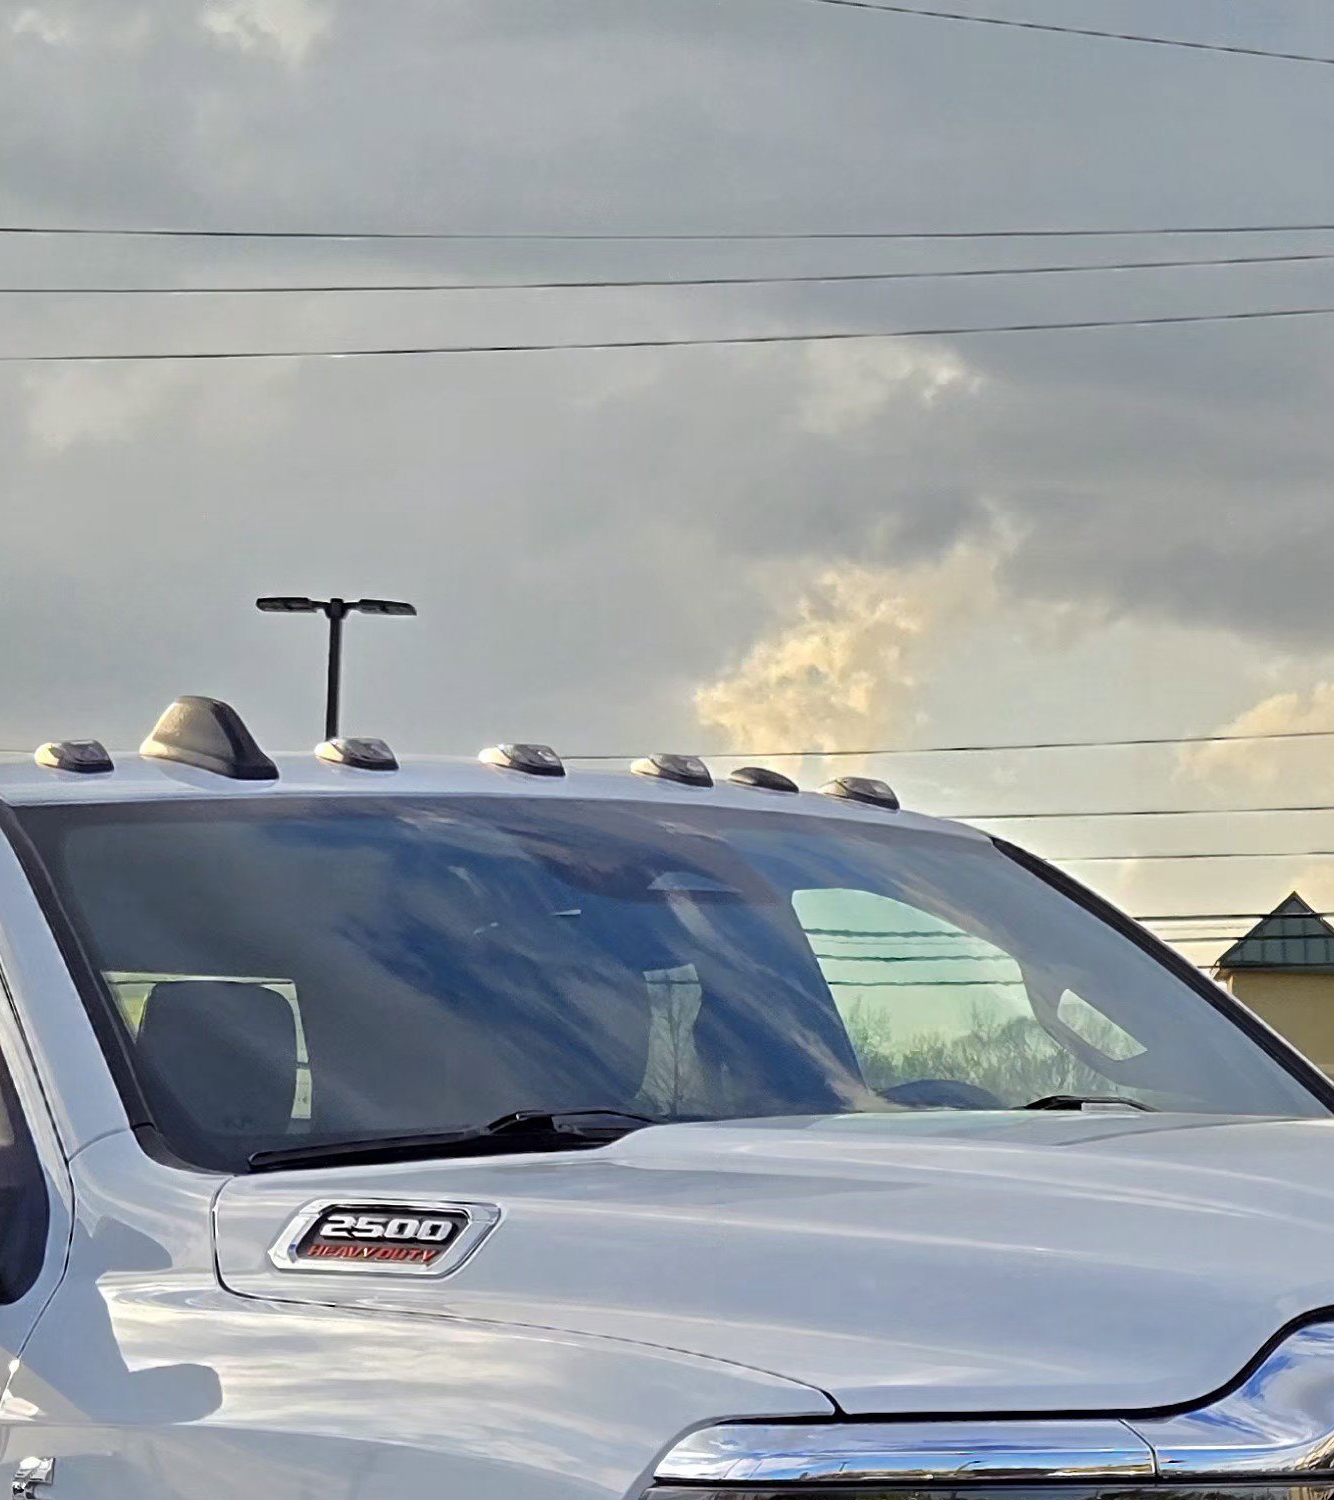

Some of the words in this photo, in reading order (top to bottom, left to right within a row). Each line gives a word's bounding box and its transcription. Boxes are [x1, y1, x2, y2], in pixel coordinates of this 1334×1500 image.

[319, 1214, 453, 1242] 2500
[306, 1245, 374, 1260] HEAVY
[373, 1247, 437, 1263] DUTY
